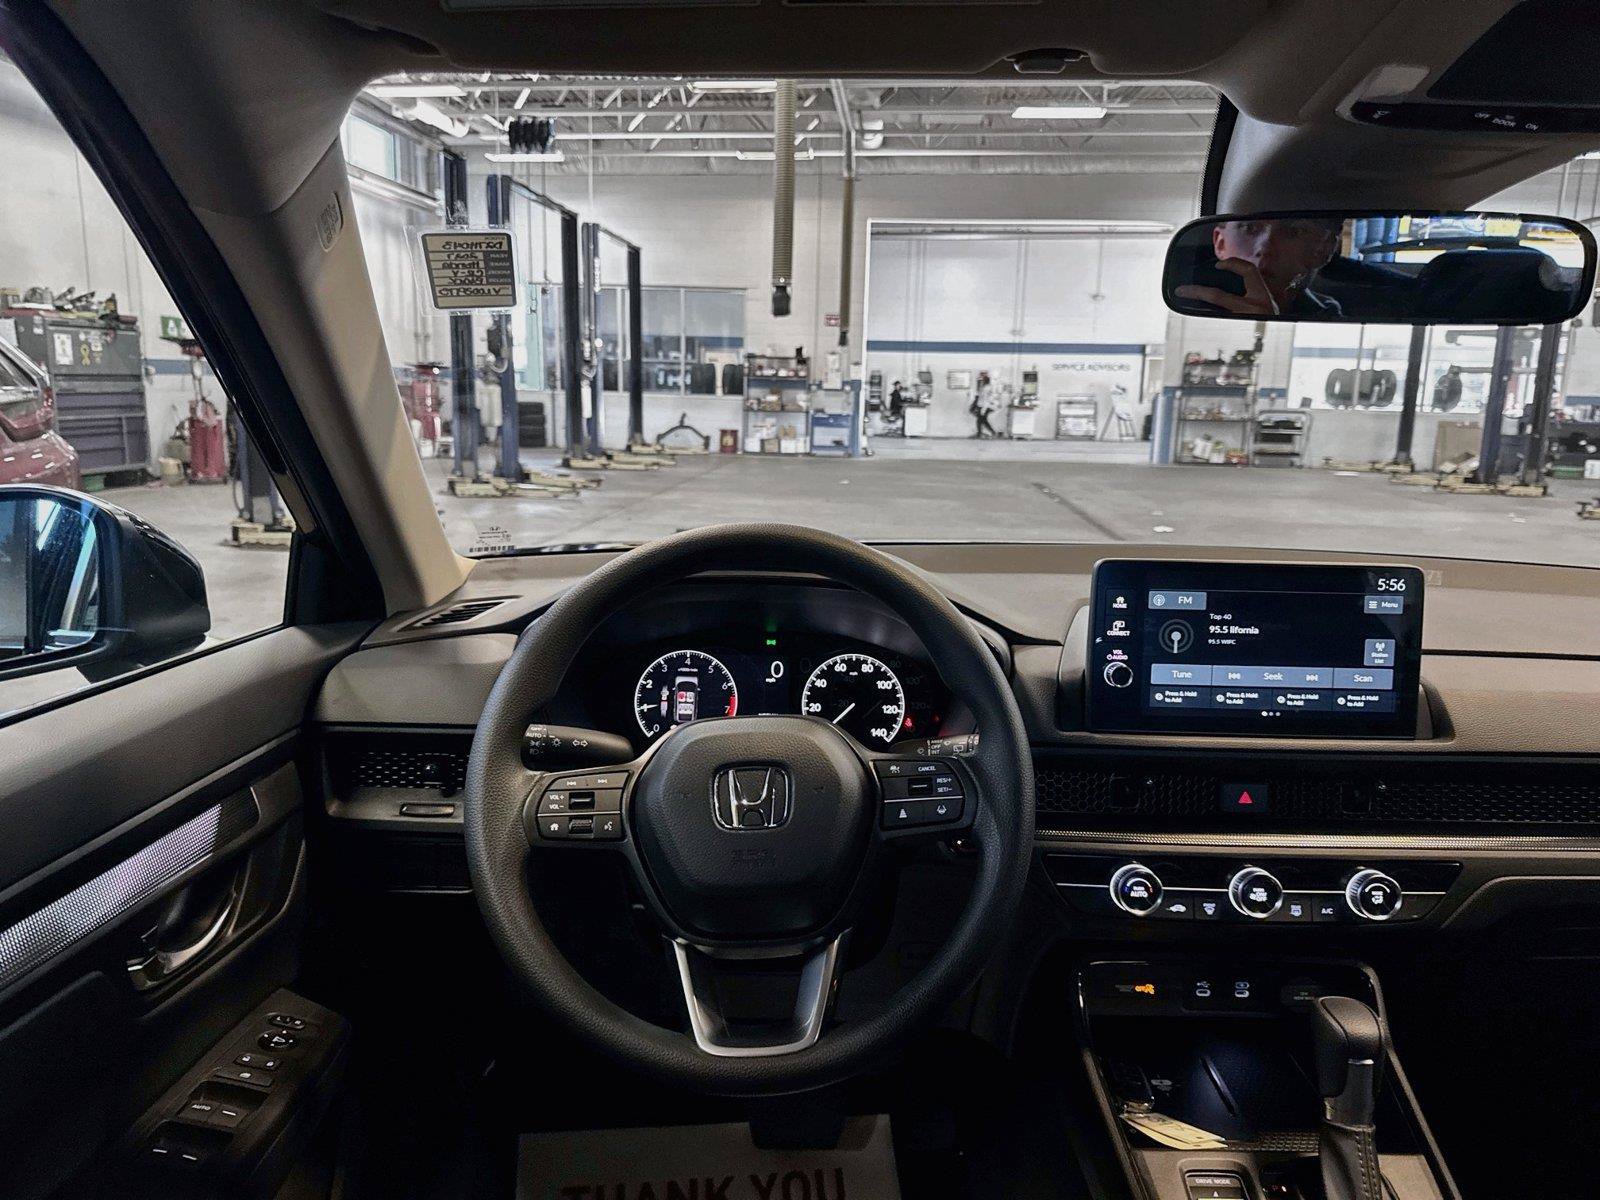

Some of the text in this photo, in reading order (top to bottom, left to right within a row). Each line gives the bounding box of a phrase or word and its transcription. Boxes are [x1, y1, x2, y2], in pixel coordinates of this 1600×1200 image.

[1377, 578, 1406, 591] 5:56
[1178, 596, 1193, 605] FM
[1381, 601, 1399, 609] Menu
[1209, 613, 1222, 621] Top
[1208, 625, 1229, 634] 95.5
[770, 660, 784, 678] 0
[834, 663, 848, 673] 60
[861, 663, 875, 673] 80
[1171, 670, 1193, 679] Tune
[1263, 672, 1284, 680] Seek
[1353, 674, 1374, 682] Scan
[814, 678, 828, 689] 40
[876, 679, 893, 690] 100
[808, 702, 822, 713] 20
[881, 704, 899, 714] 120
[870, 728, 888, 738] 140
